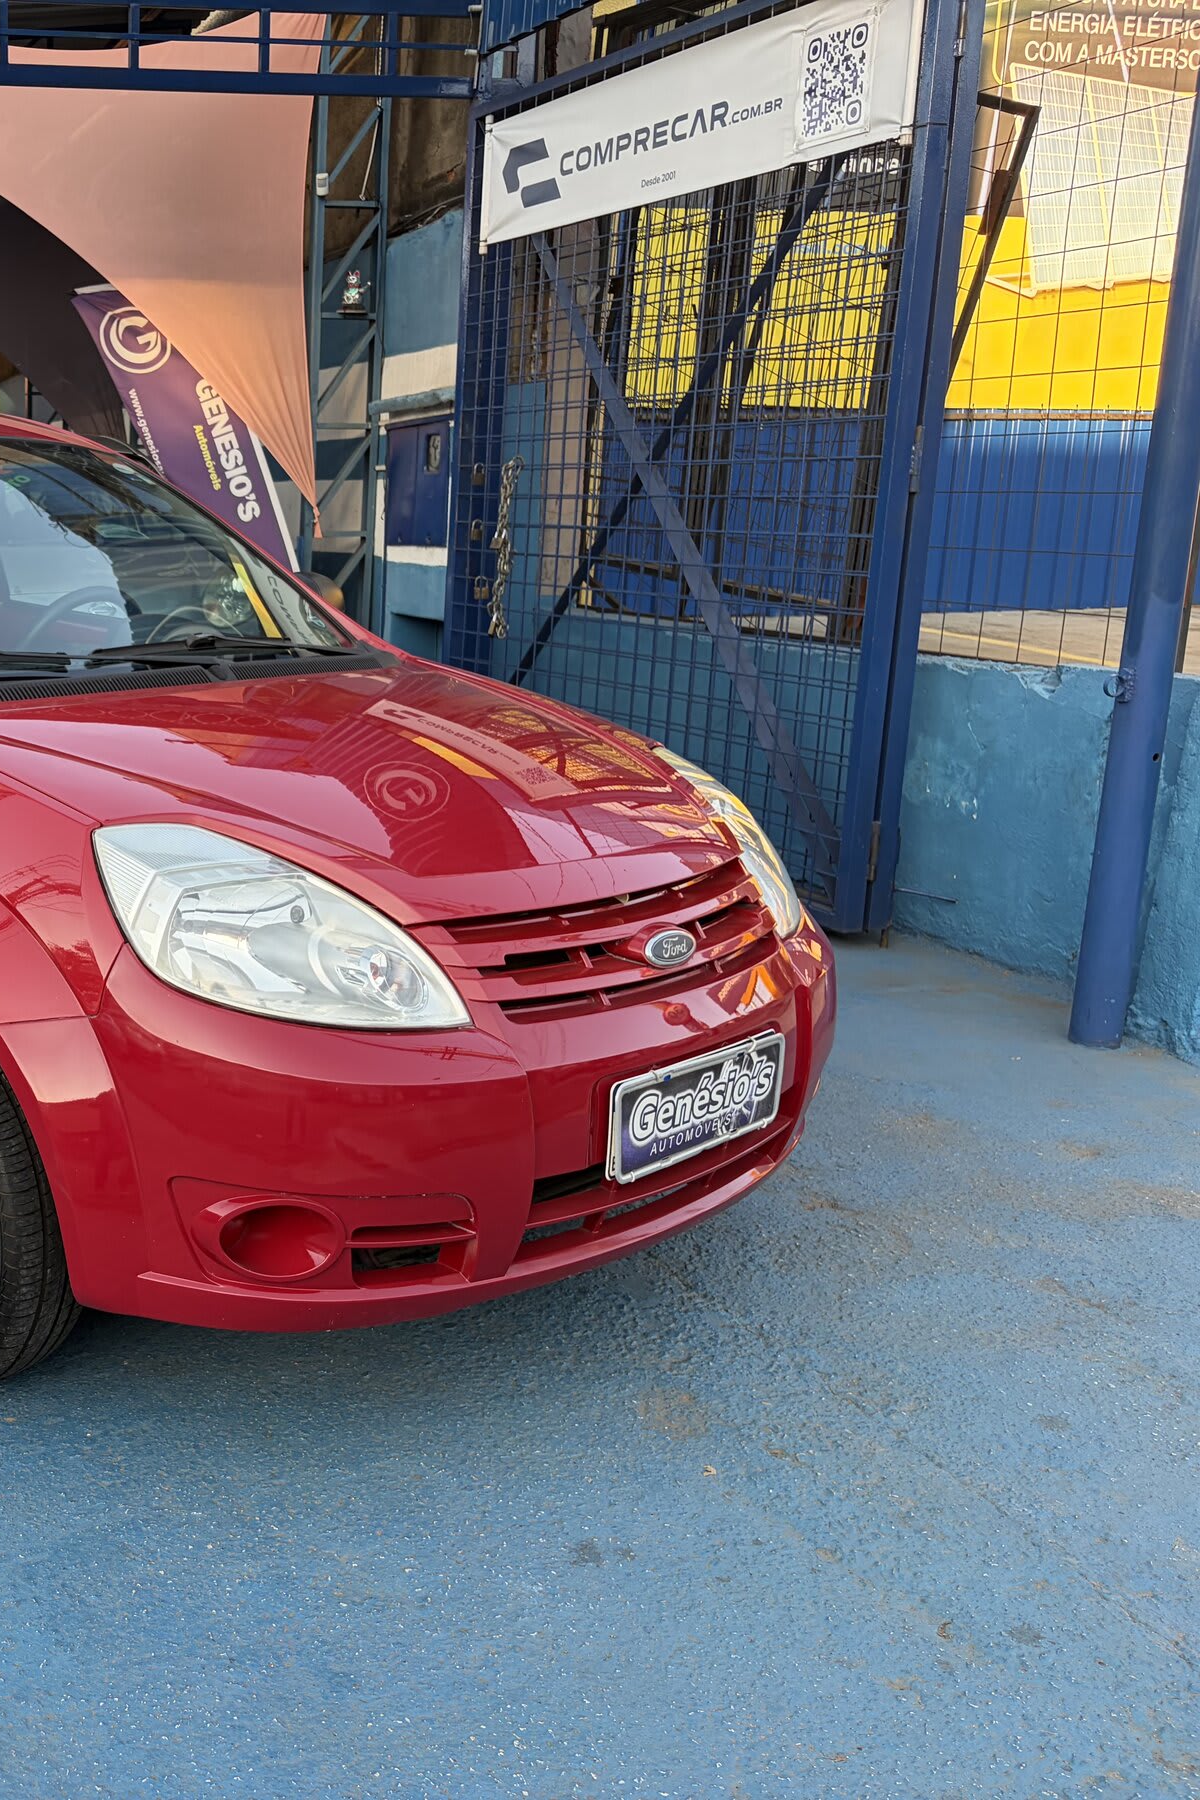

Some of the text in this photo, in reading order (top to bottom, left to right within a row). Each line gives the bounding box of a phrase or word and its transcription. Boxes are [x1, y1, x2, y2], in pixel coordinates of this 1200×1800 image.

[1029, 11, 1118, 35] ENERGIA
[1024, 41, 1076, 63] COM
[1076, 45, 1090, 62] A
[641, 170, 676, 188] Desde 2001
[193, 424, 222, 492] Automóveis
[662, 936, 688, 958] Ford
[631, 1060, 774, 1142] Genésio's
